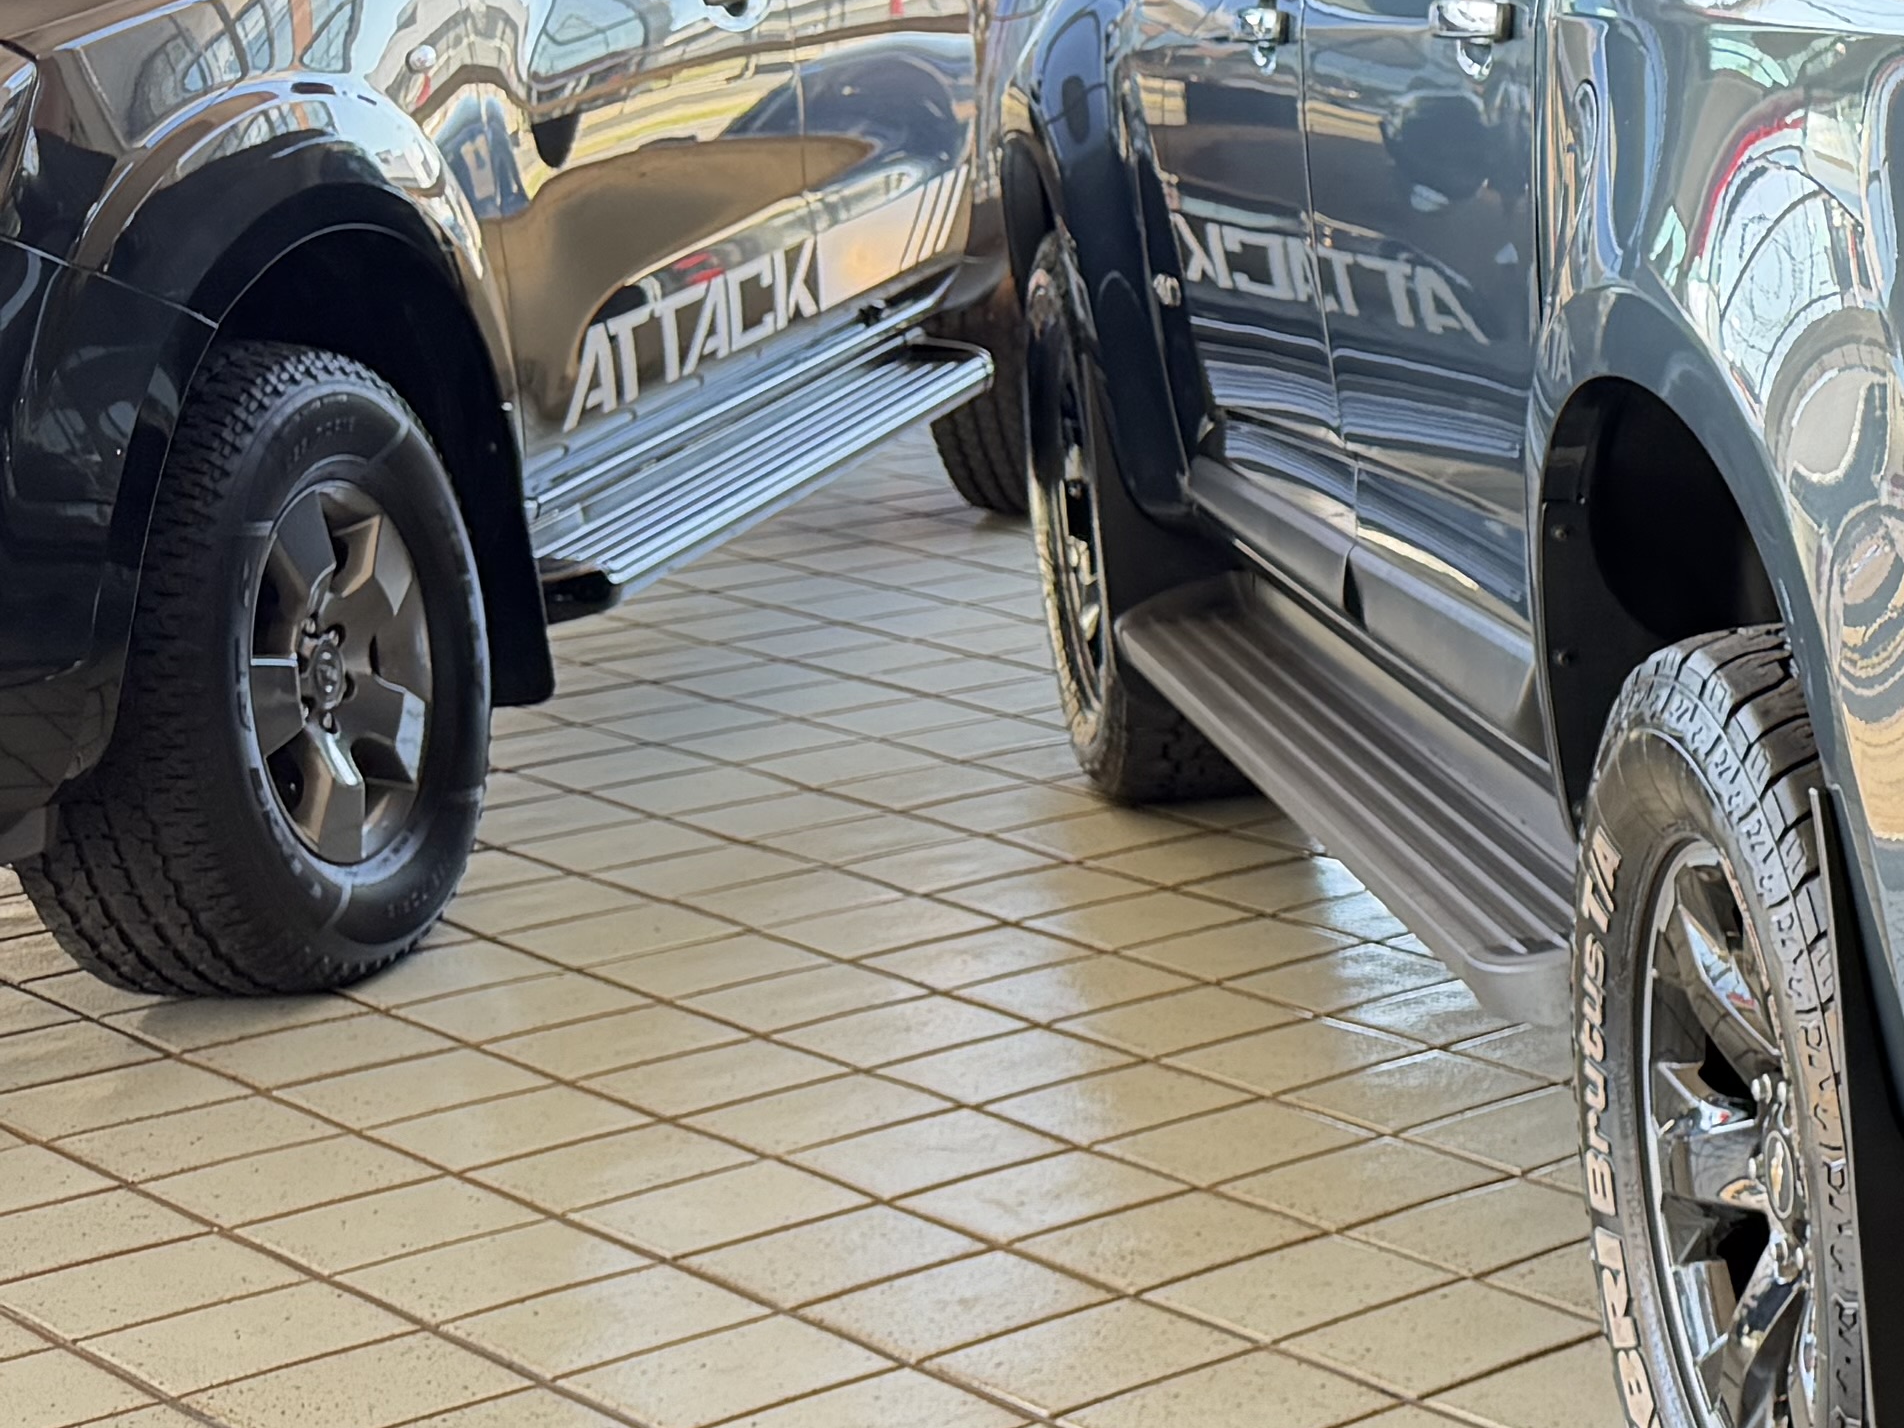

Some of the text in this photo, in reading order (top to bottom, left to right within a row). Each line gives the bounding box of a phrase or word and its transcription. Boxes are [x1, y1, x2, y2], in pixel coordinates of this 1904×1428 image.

[563, 234, 818, 433] ATTACK
[1582, 825, 1621, 933] T/A
[1582, 933, 1617, 1217] Brutus
